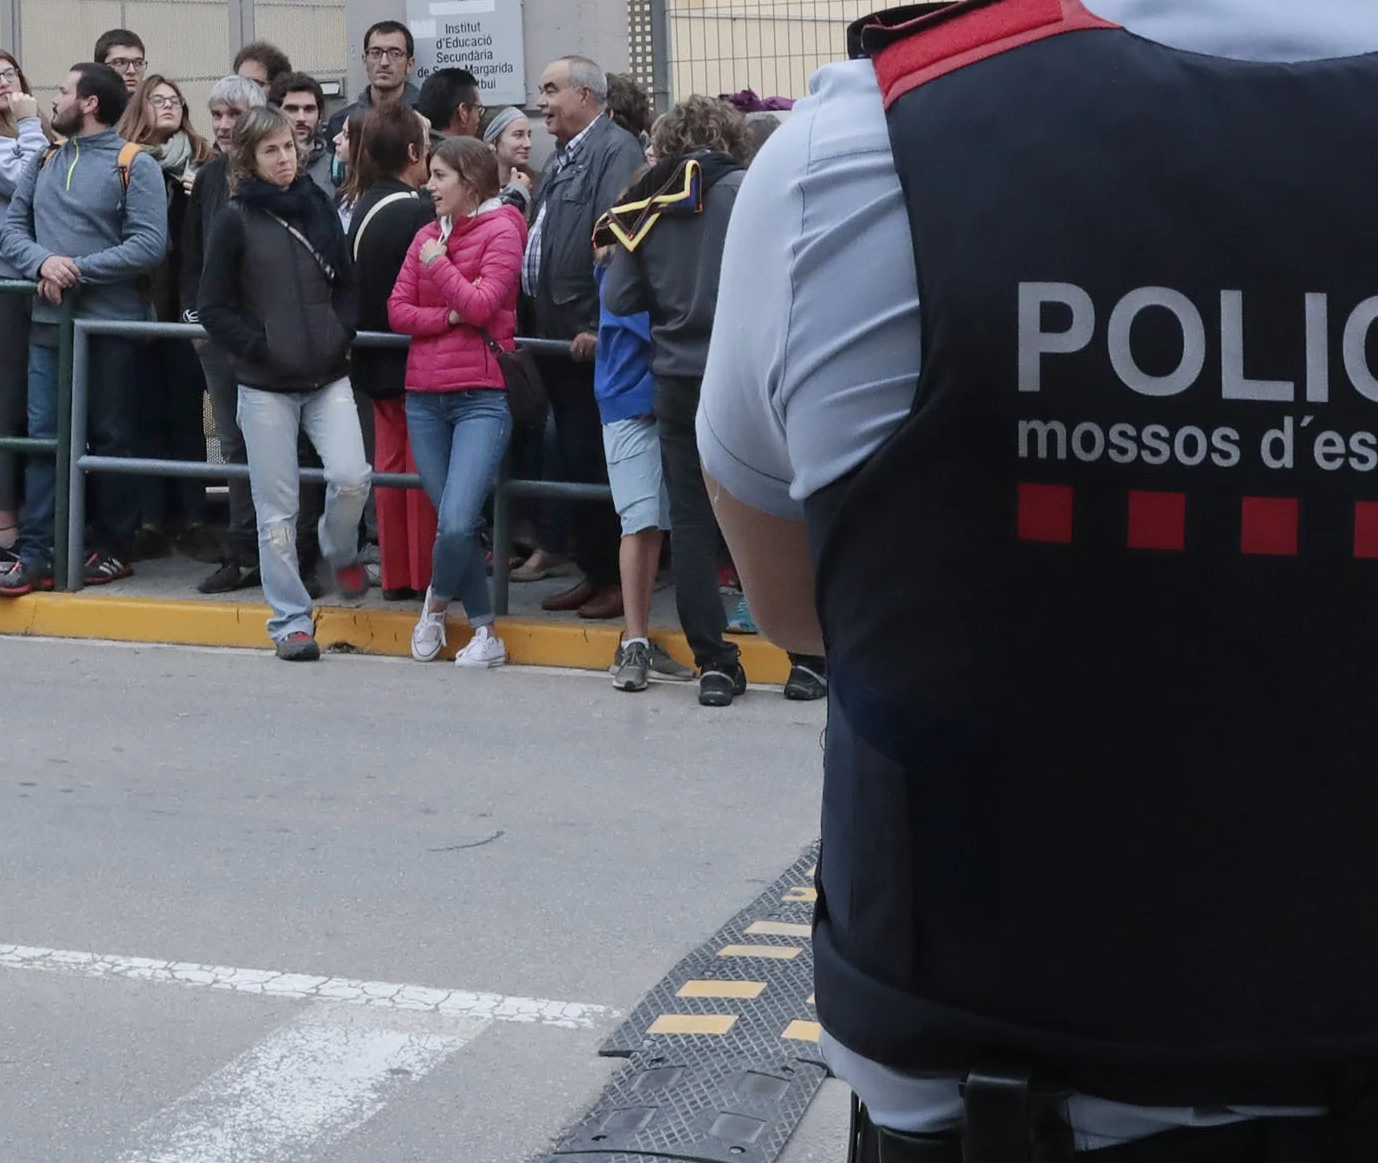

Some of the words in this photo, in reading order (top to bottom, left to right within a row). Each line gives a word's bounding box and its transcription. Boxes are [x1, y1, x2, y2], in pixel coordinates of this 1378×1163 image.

[445, 21, 481, 34] Institut
[436, 34, 493, 49] d'Educació
[436, 49, 493, 64] Secundària
[417, 66, 430, 78] de
[465, 62, 513, 77] Margarida
[1017, 417, 1242, 468] mossos
